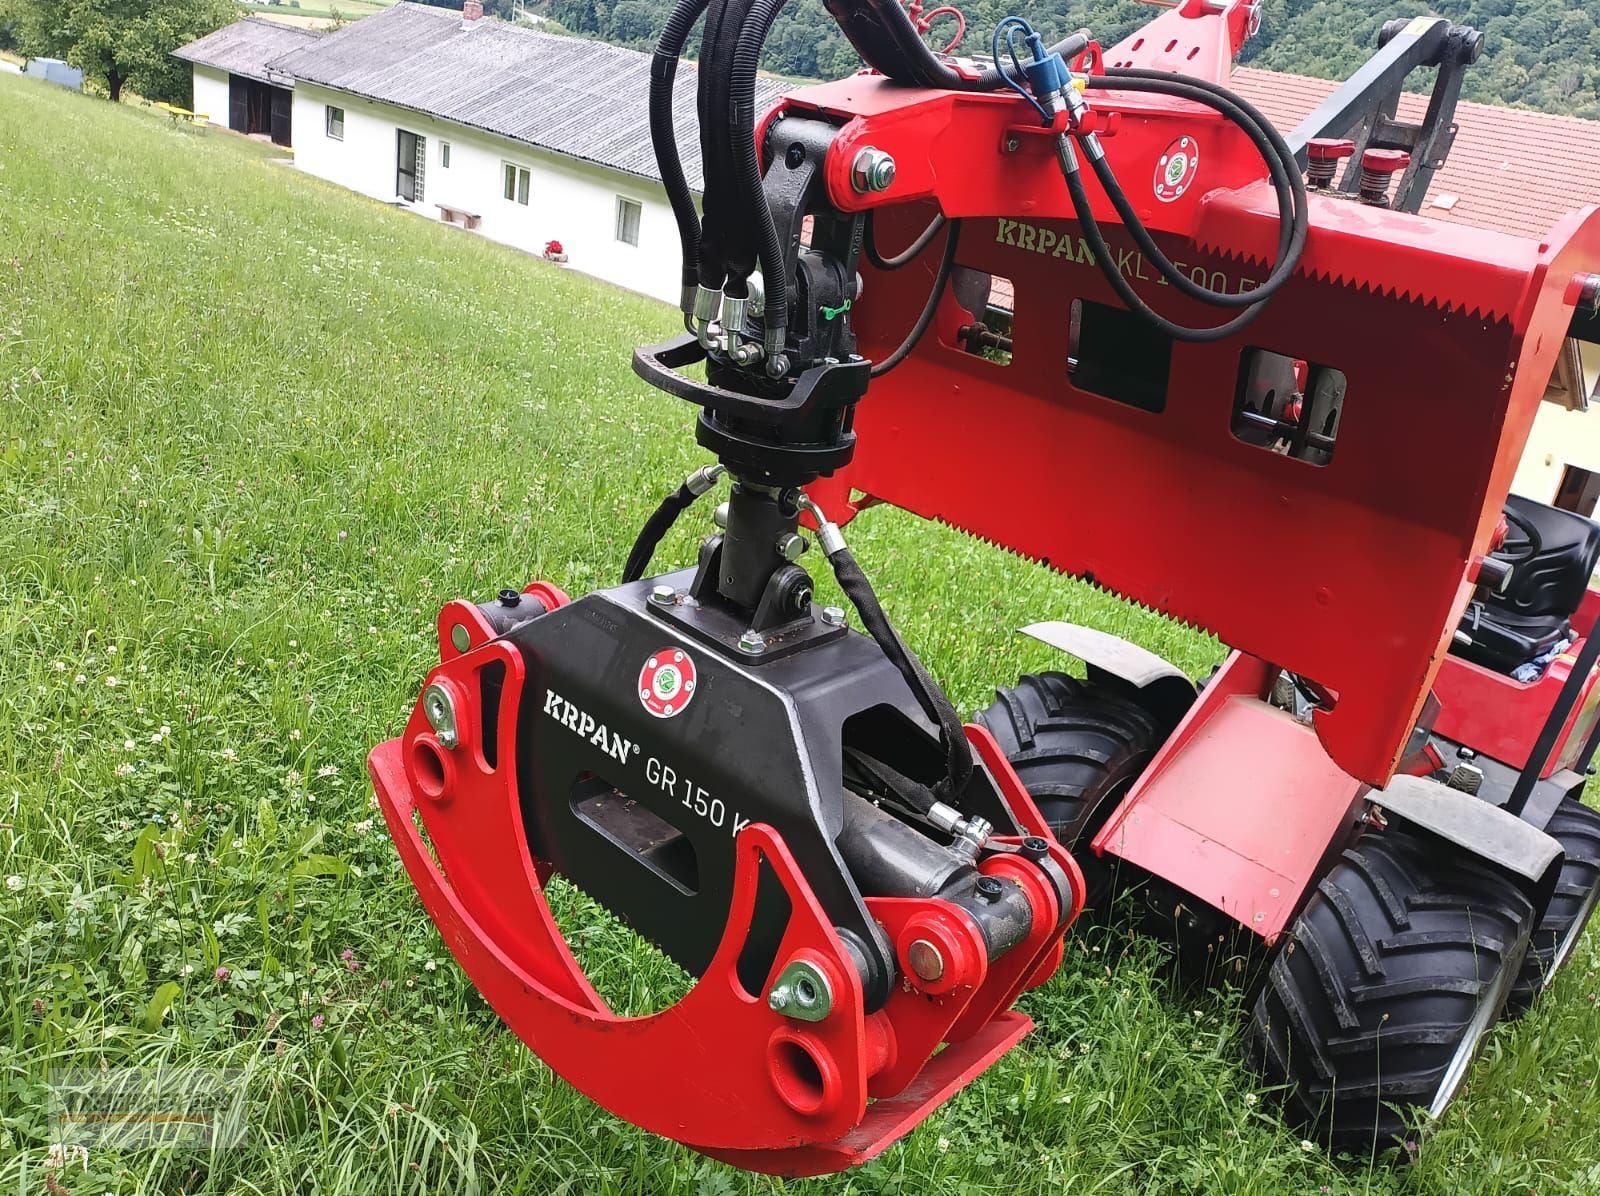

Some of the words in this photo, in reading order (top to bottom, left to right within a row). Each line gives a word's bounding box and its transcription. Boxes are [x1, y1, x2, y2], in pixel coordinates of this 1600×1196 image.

[995, 217, 1097, 267] KRPAN
[1118, 247, 1149, 280] KL
[543, 688, 632, 765] KRPAN
[645, 757, 678, 797] GR
[681, 778, 726, 828] 150
